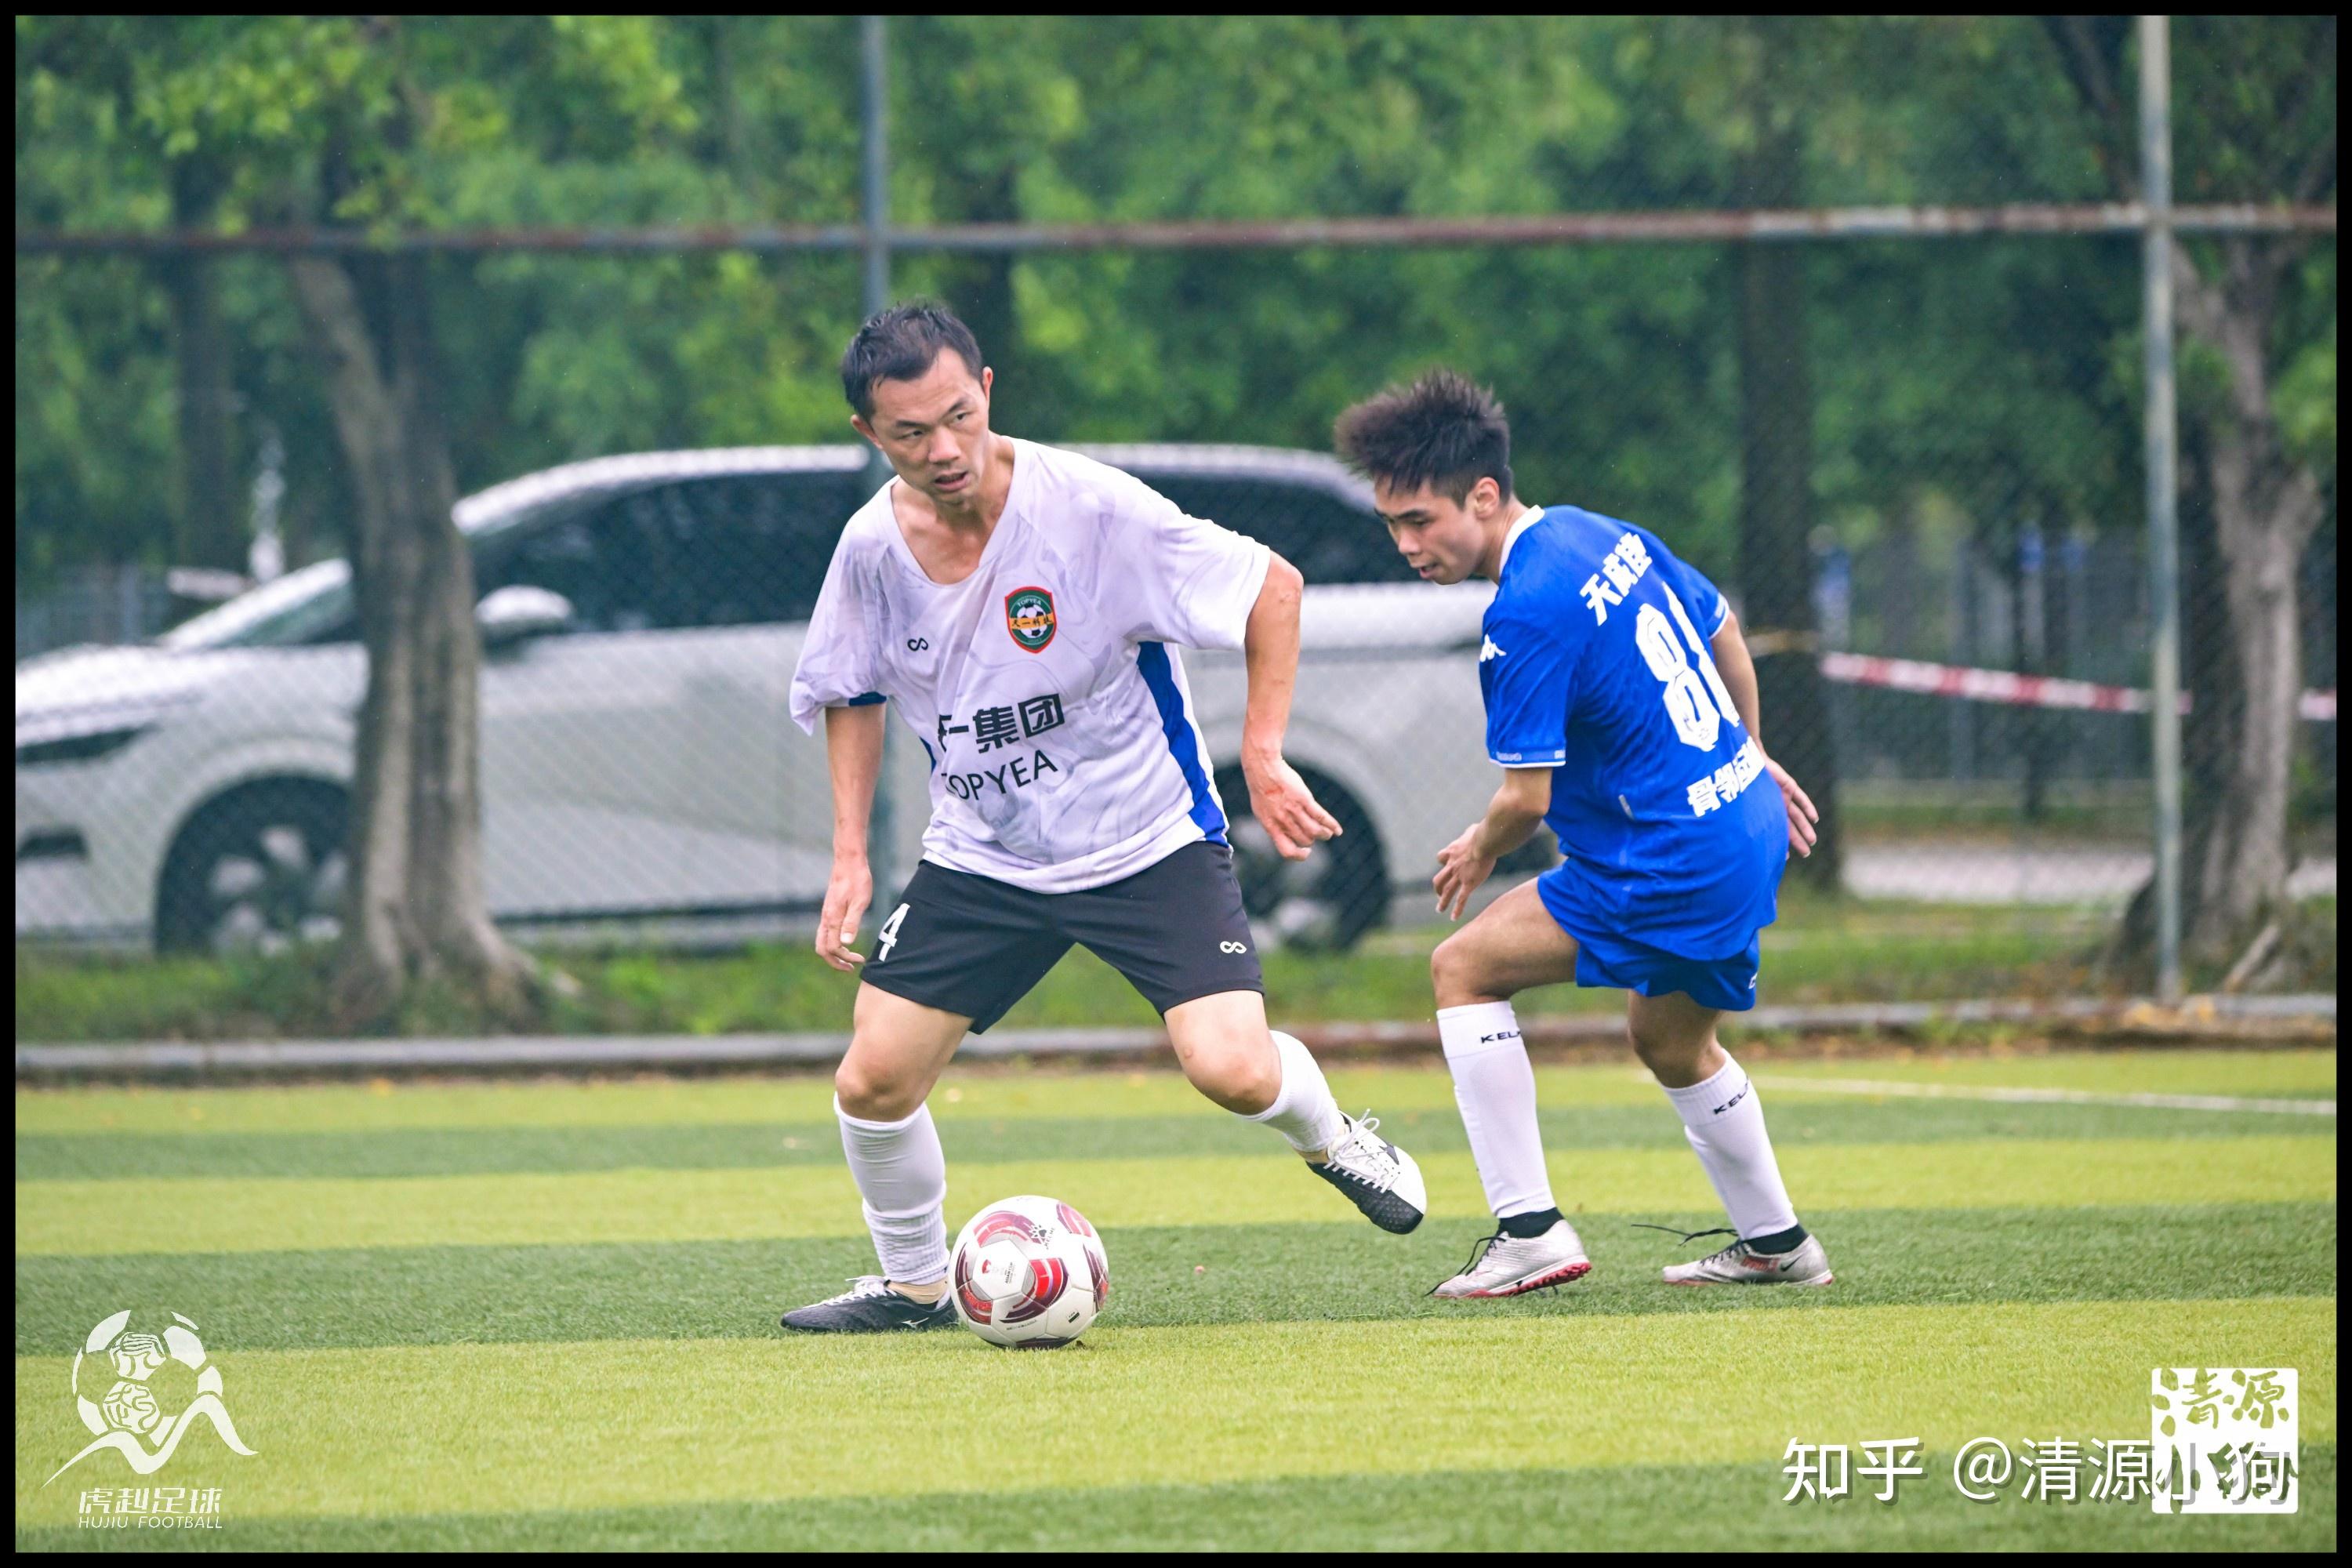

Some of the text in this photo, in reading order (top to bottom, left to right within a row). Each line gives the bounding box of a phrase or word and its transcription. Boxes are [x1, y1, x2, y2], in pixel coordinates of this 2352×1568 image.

[1017, 597, 1042, 607] TOPYEA
[941, 750, 1058, 800] OPYEA
[878, 902, 910, 962] 4
